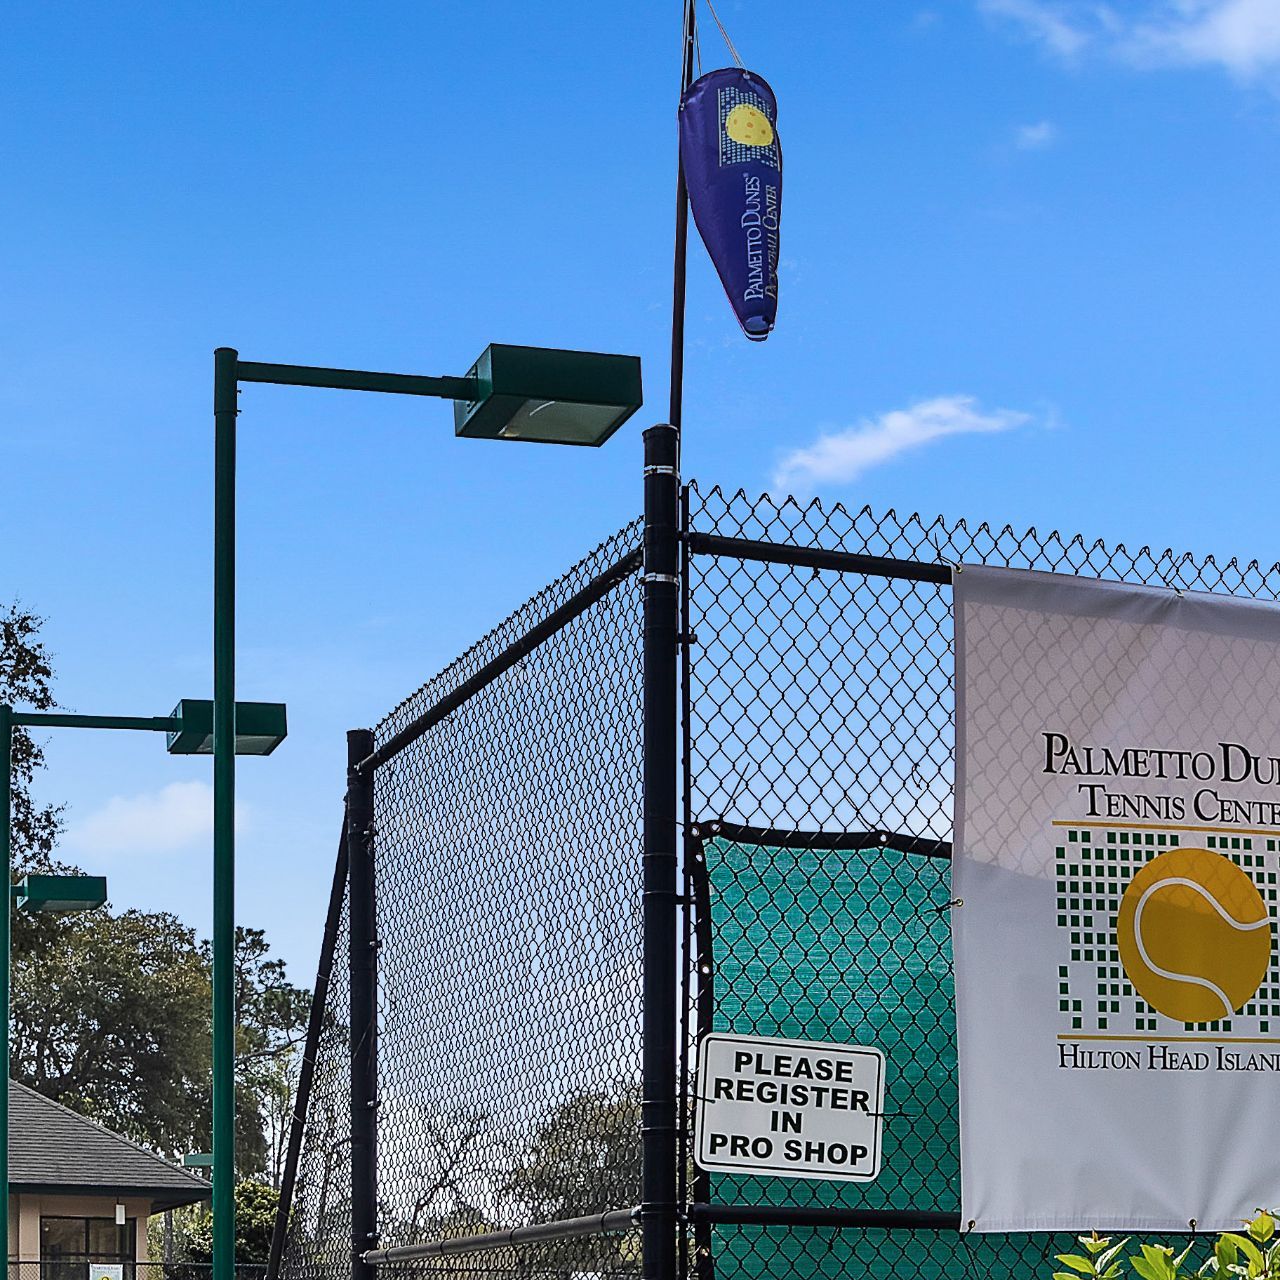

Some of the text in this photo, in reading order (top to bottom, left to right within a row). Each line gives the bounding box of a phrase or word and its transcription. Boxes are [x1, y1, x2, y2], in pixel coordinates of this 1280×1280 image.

[762, 184, 778, 230] CENTER
[744, 227, 764, 301] PALMETTO
[1042, 732, 1216, 781] PALMETTO
[1078, 783, 1185, 821] TENNIS
[734, 1051, 853, 1083] PLEASE
[1057, 1043, 1141, 1070] HILTON
[1147, 1045, 1209, 1071] HEAD
[714, 1077, 870, 1112] REGISTER
[770, 1110, 803, 1134] IN
[709, 1133, 868, 1166] PRO SHOP
